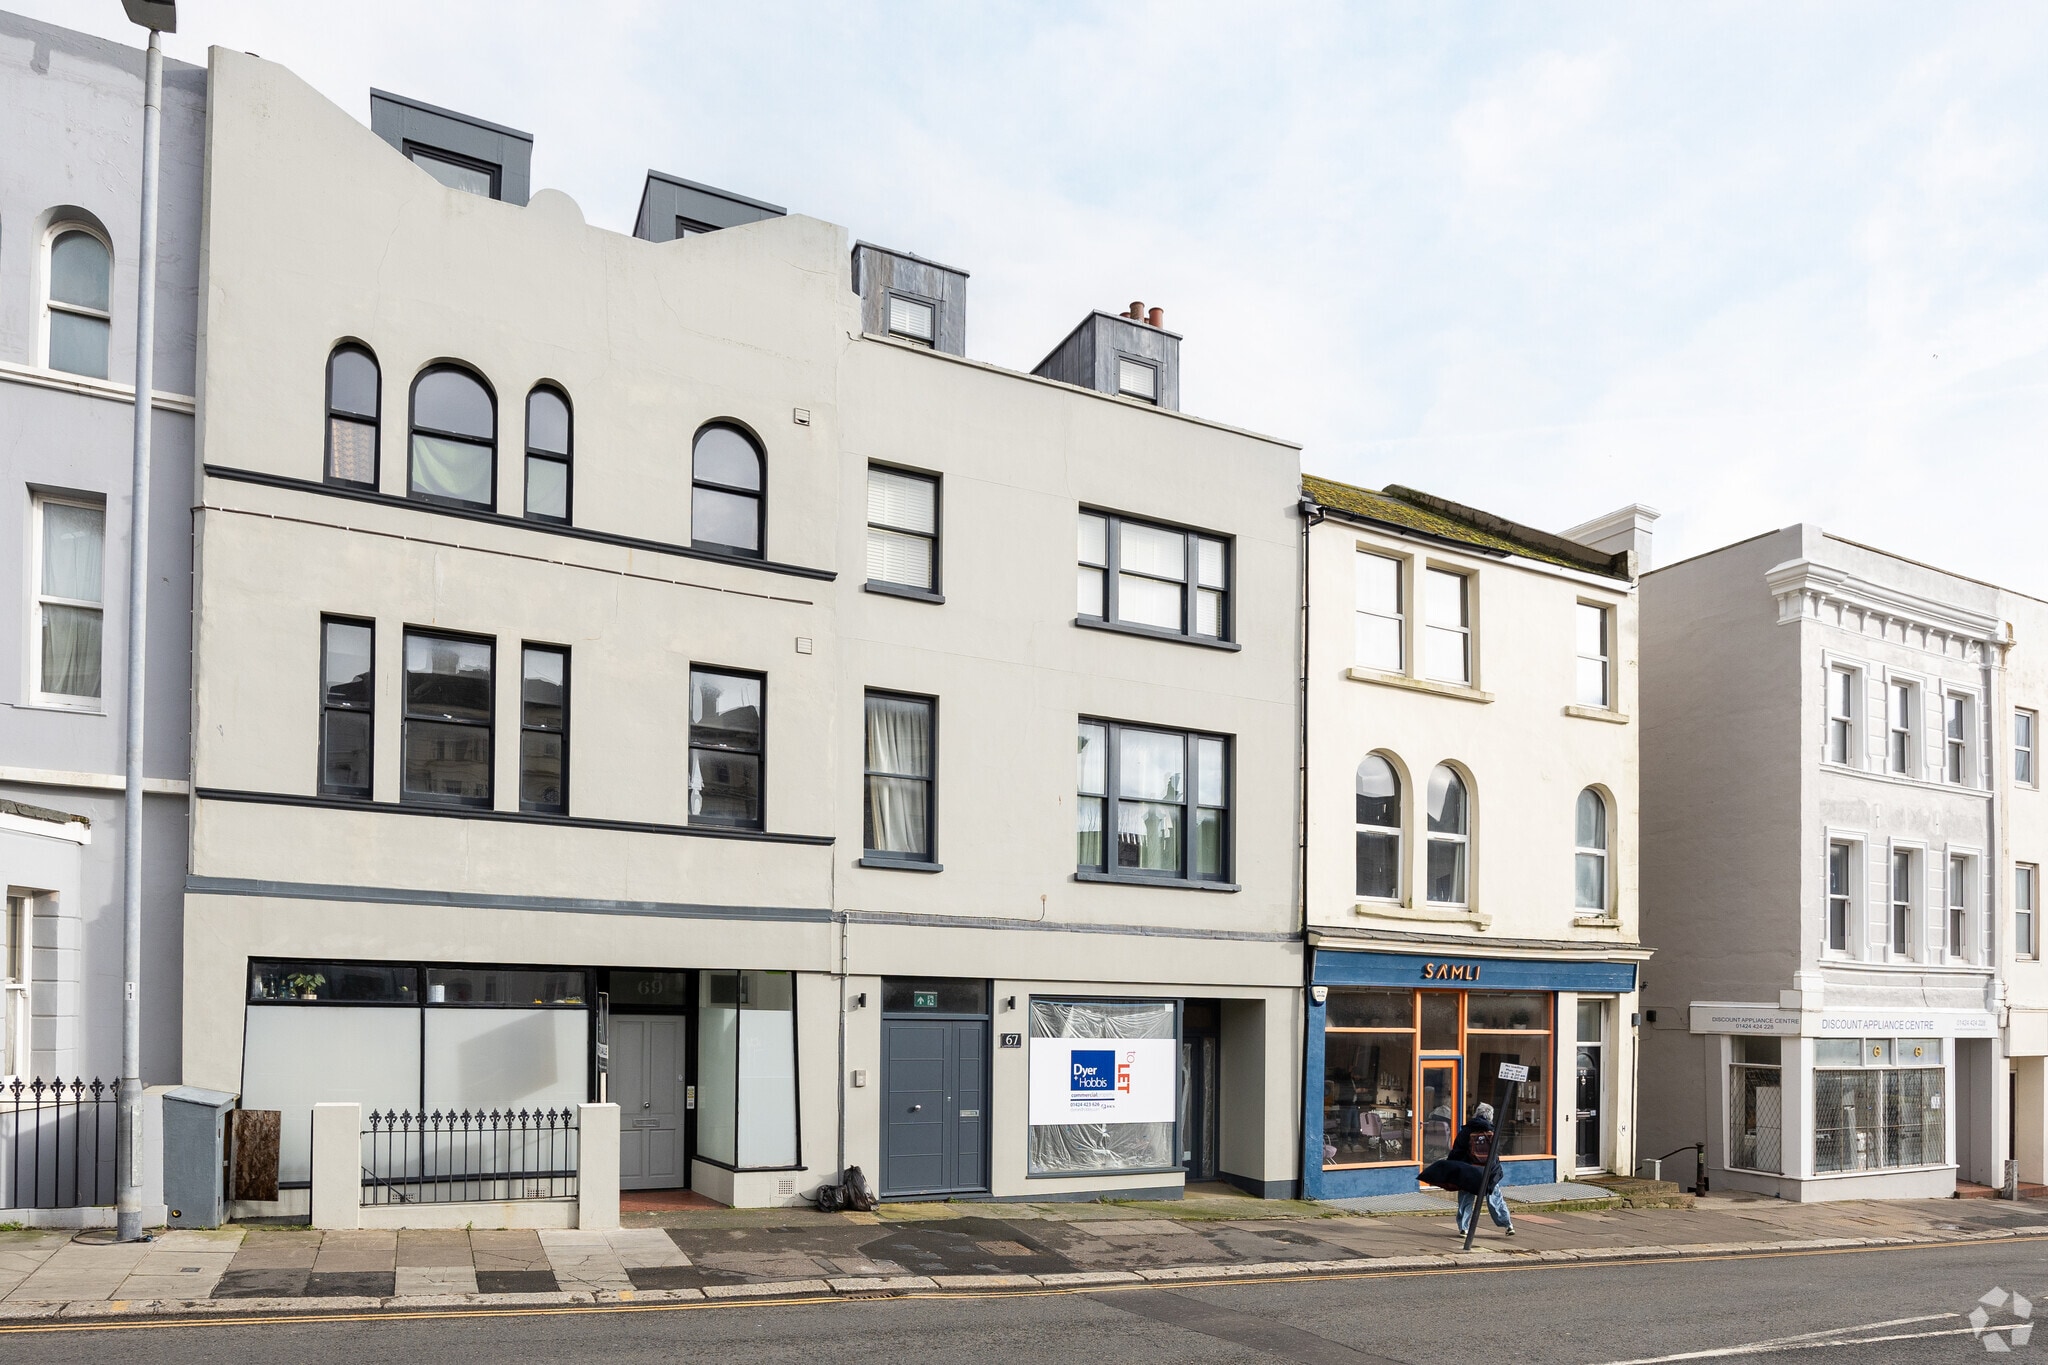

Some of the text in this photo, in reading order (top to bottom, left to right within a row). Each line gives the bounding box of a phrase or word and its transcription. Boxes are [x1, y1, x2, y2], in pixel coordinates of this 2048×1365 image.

[638, 980, 663, 995] 69
[1821, 1019, 1934, 1030] DISCOUNT APPLIANCE CENTRE
[1005, 1034, 1019, 1045] 67
[1073, 1063, 1097, 1078] Dyer
[1079, 1077, 1107, 1088] Hobbis
[1117, 1064, 1130, 1094] LET
